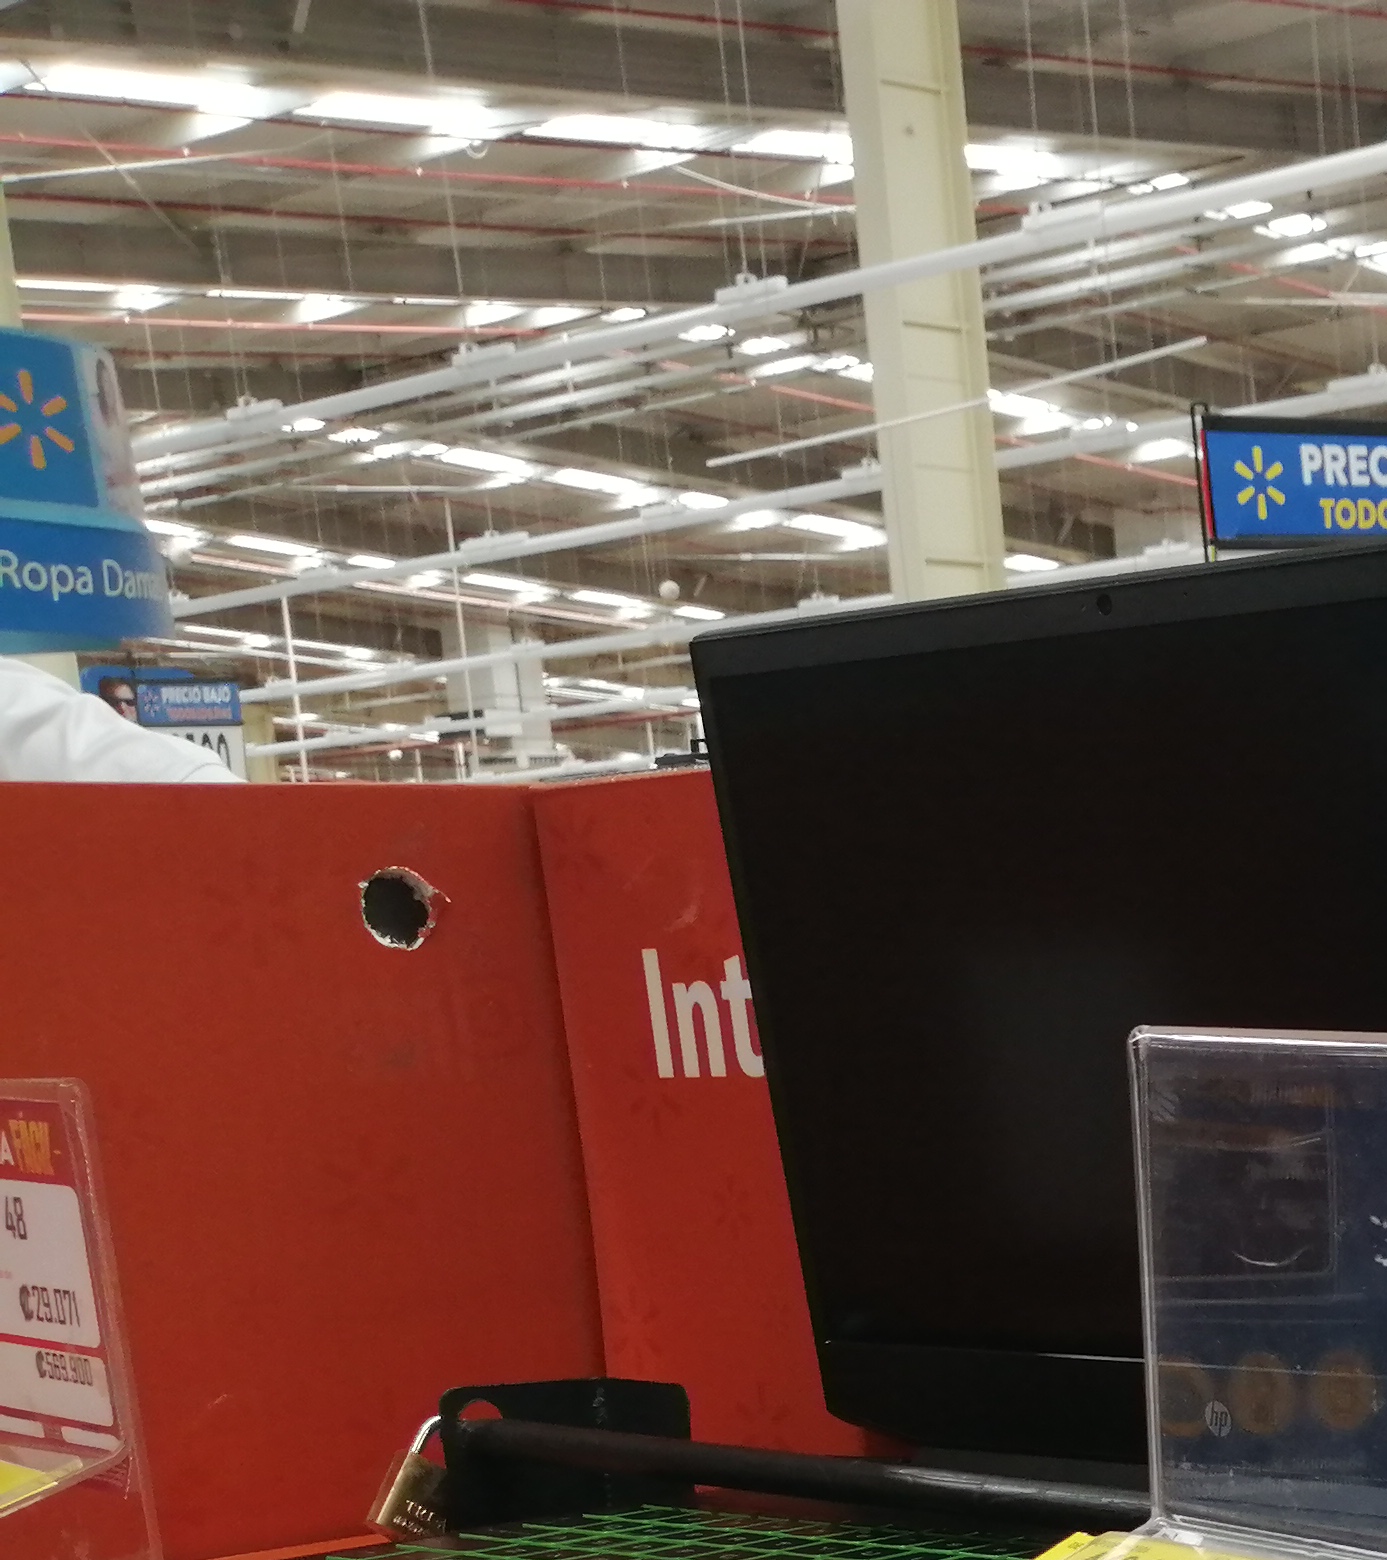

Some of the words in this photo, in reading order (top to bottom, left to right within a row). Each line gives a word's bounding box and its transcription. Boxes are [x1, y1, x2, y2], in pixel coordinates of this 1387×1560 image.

[0, 549, 94, 601] Ropa
[102, 558, 158, 600] Dam
[641, 948, 765, 1079] Int
[1206, 1402, 1231, 1437] hp
